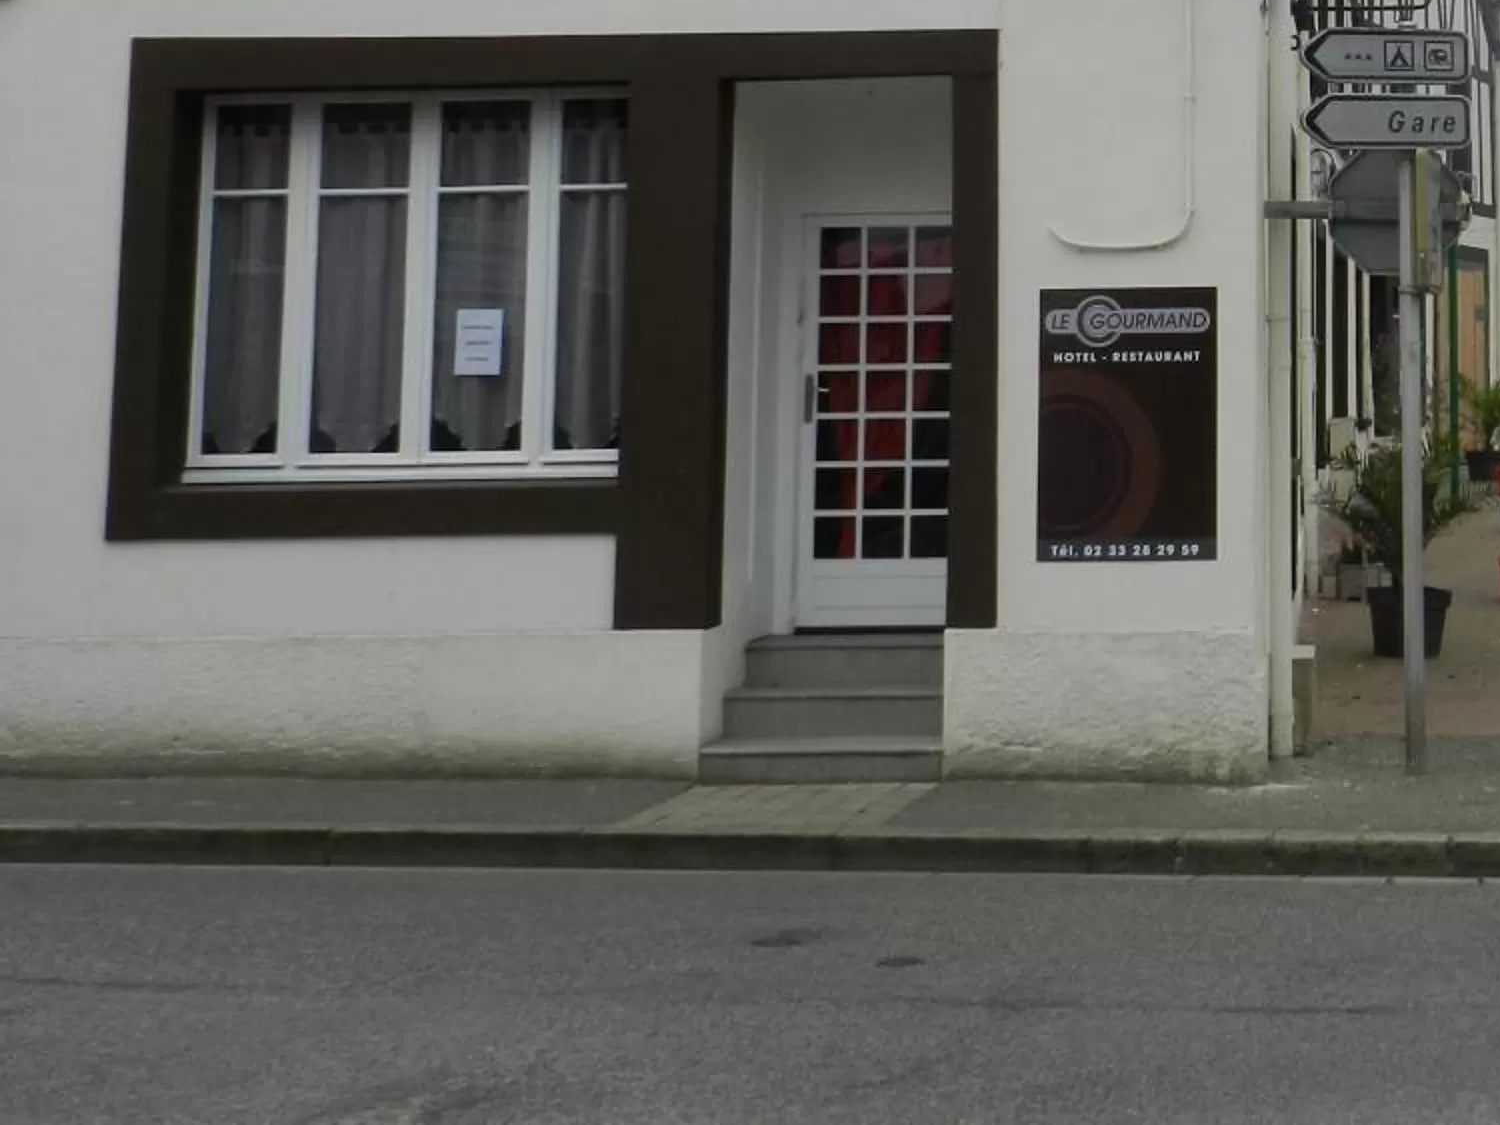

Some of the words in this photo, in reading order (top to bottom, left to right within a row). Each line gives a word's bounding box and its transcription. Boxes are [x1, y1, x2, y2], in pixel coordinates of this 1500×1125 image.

[1388, 110, 1457, 134] Gare
[1050, 313, 1072, 330] LE
[1089, 311, 1208, 331] GOURMAND
[1053, 350, 1097, 363] HOTEL
[1111, 350, 1201, 363] RESTAURANT
[1050, 543, 1079, 557] Tél.
[1083, 544, 1103, 556] 02
[1107, 544, 1127, 556] 33
[1157, 544, 1175, 556] 29
